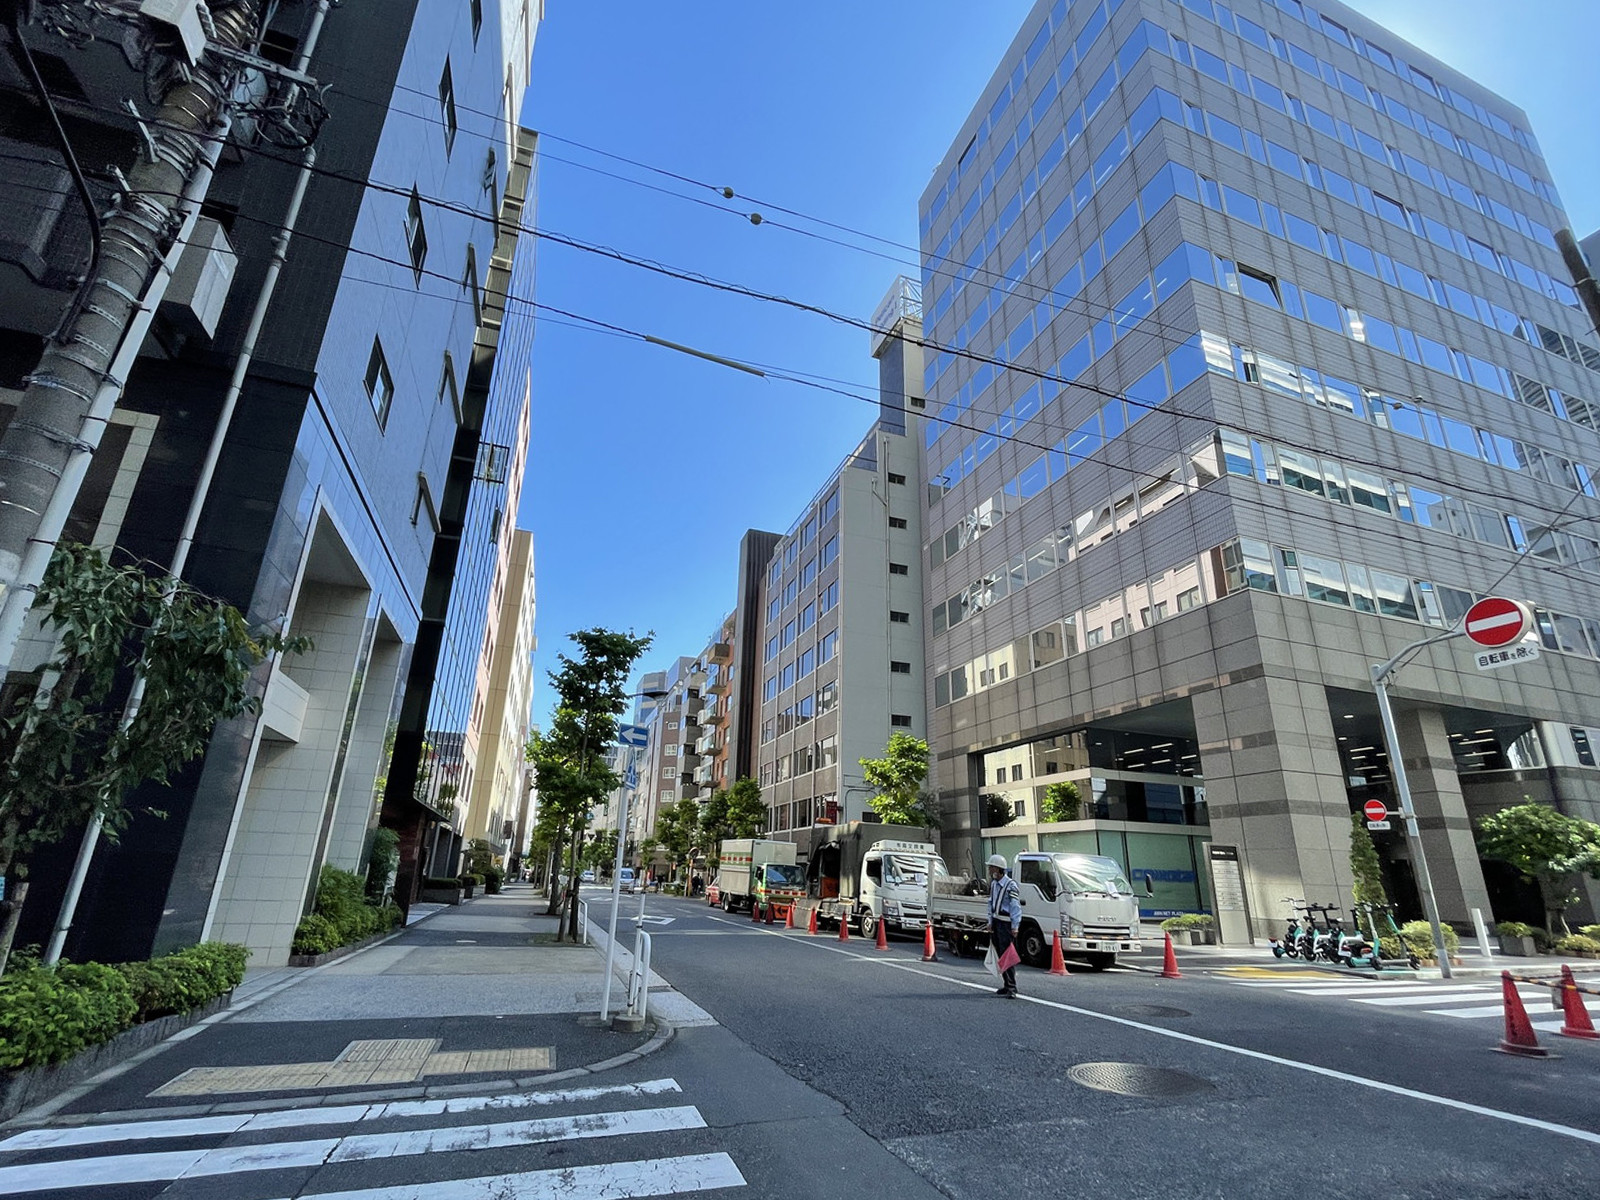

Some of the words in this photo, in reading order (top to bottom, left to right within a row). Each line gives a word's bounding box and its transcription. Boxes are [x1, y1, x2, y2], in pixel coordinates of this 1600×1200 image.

[1478, 646, 1535, 666] 自転車を除く
